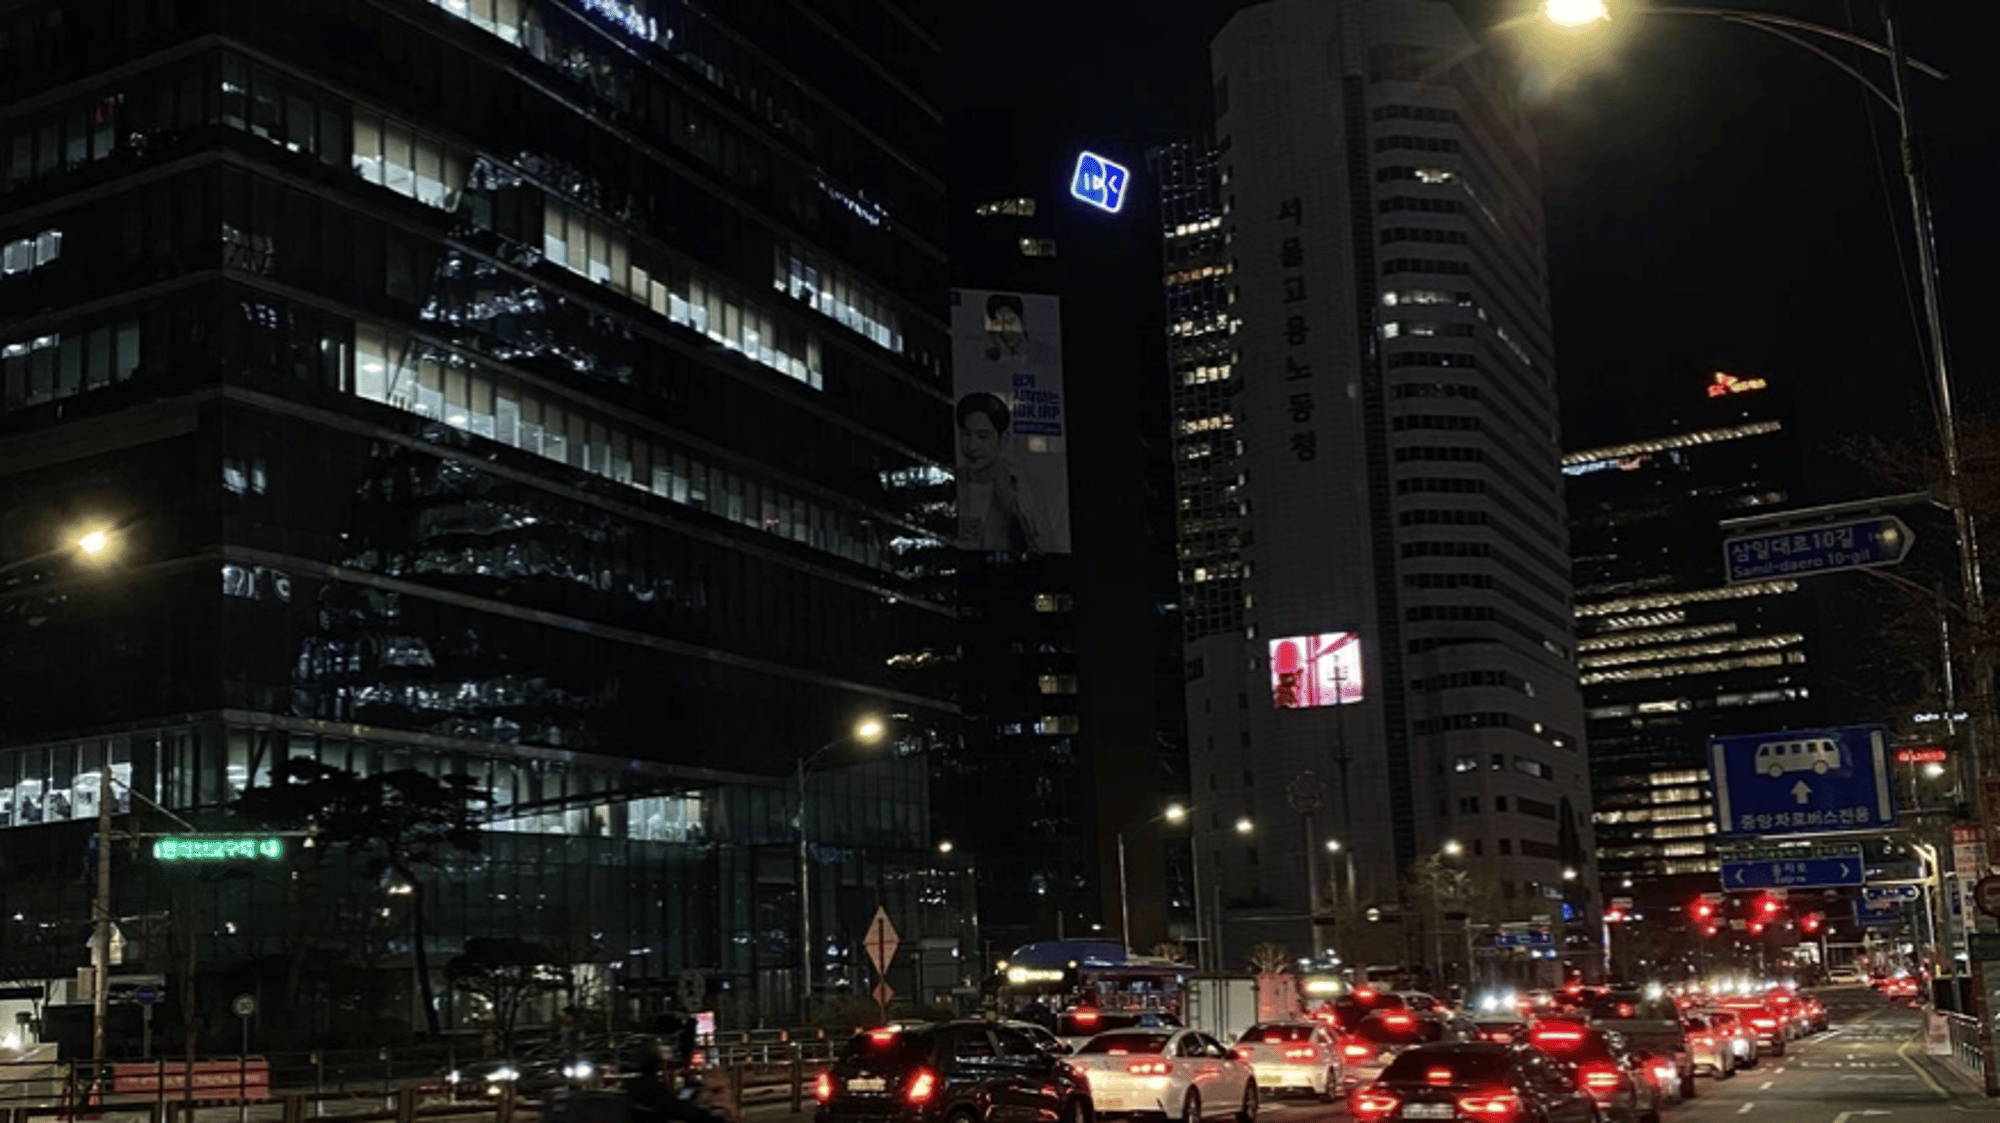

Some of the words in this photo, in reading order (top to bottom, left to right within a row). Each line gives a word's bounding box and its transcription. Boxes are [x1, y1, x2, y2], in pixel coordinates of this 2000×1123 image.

[1277, 196, 1317, 462] 서울고용노동청
[1732, 527, 1854, 562] 삼일대로10길
[1733, 557, 1823, 579] Samil-daero
[1827, 549, 1870, 567] 10-gil
[1740, 806, 1870, 831] 중앙차로버스전용
